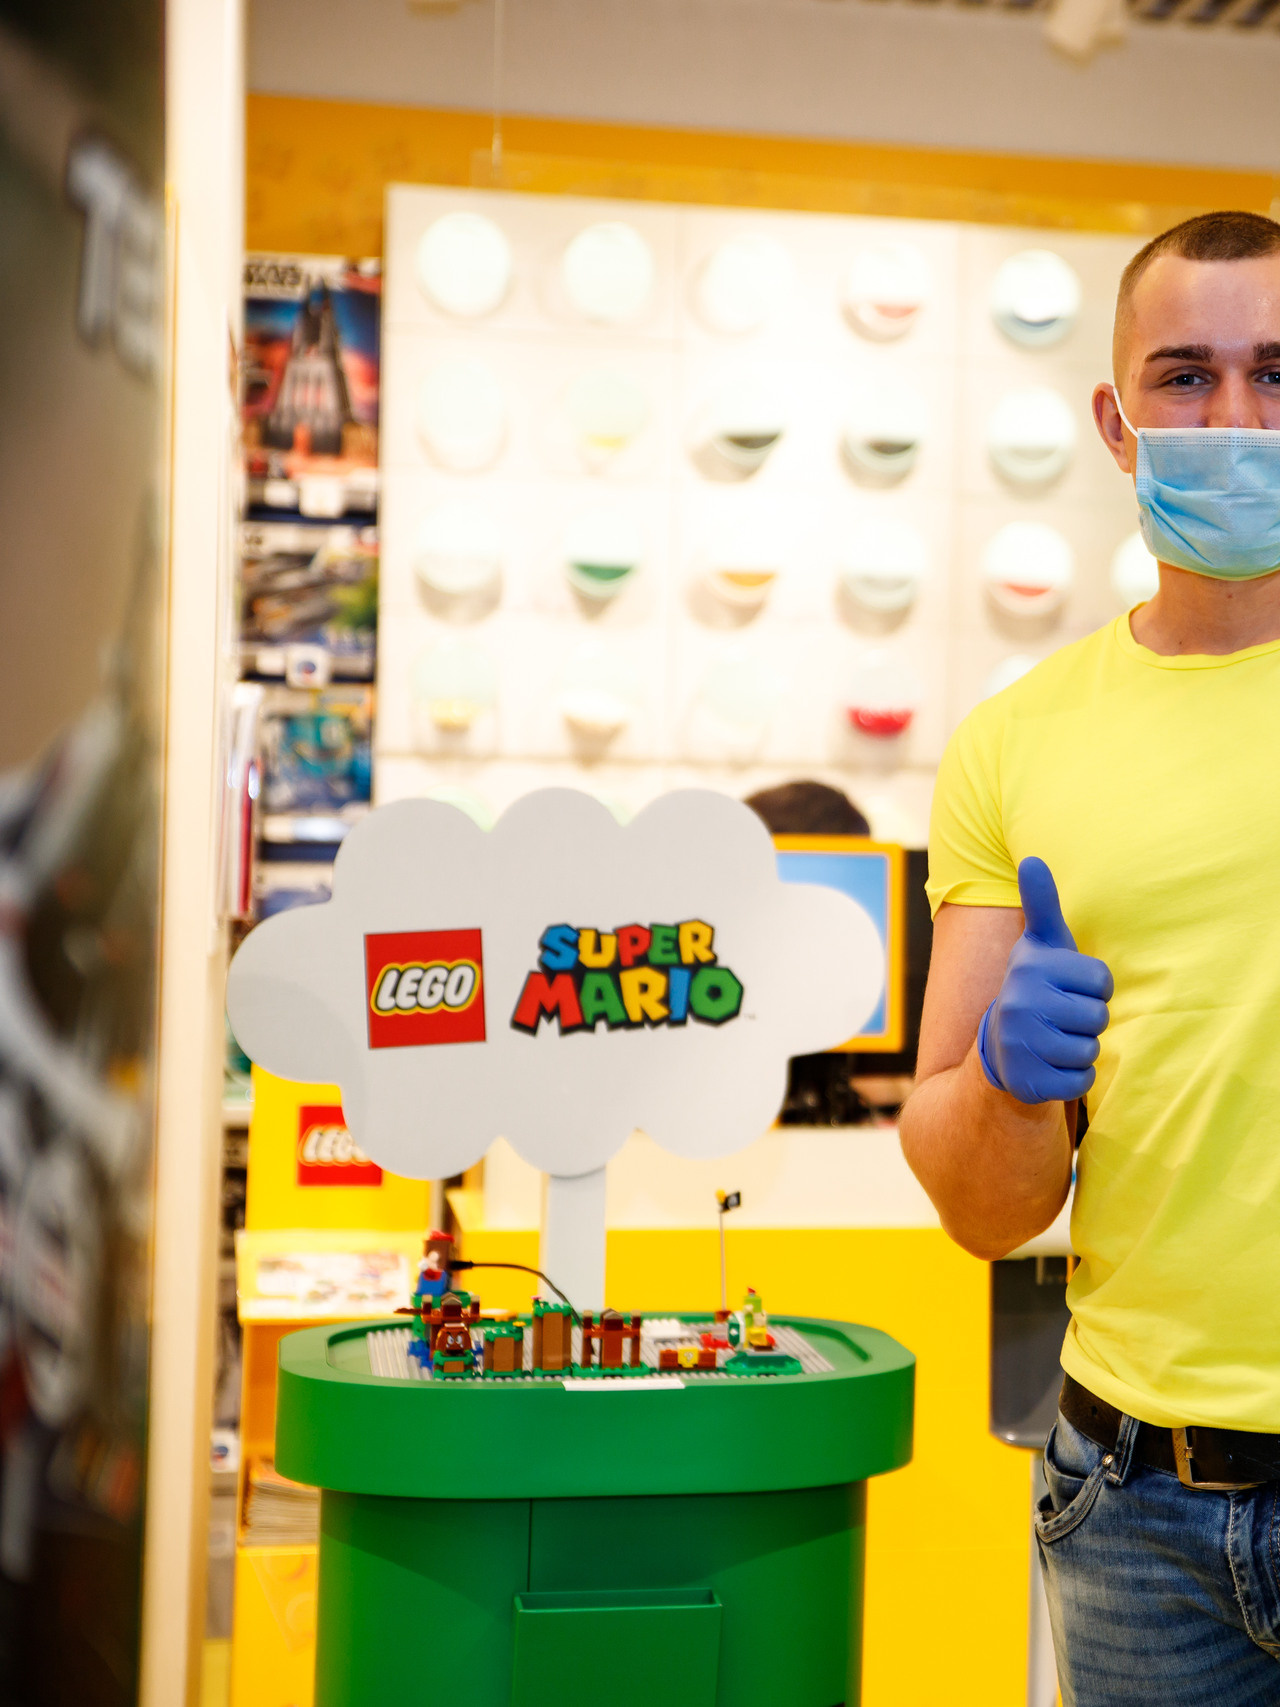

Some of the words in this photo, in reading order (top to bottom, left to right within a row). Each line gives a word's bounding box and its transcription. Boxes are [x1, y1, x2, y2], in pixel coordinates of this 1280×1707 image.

[538, 919, 717, 971] SUPER
[373, 962, 479, 1013] LEGO
[510, 966, 743, 1035] MARIO
